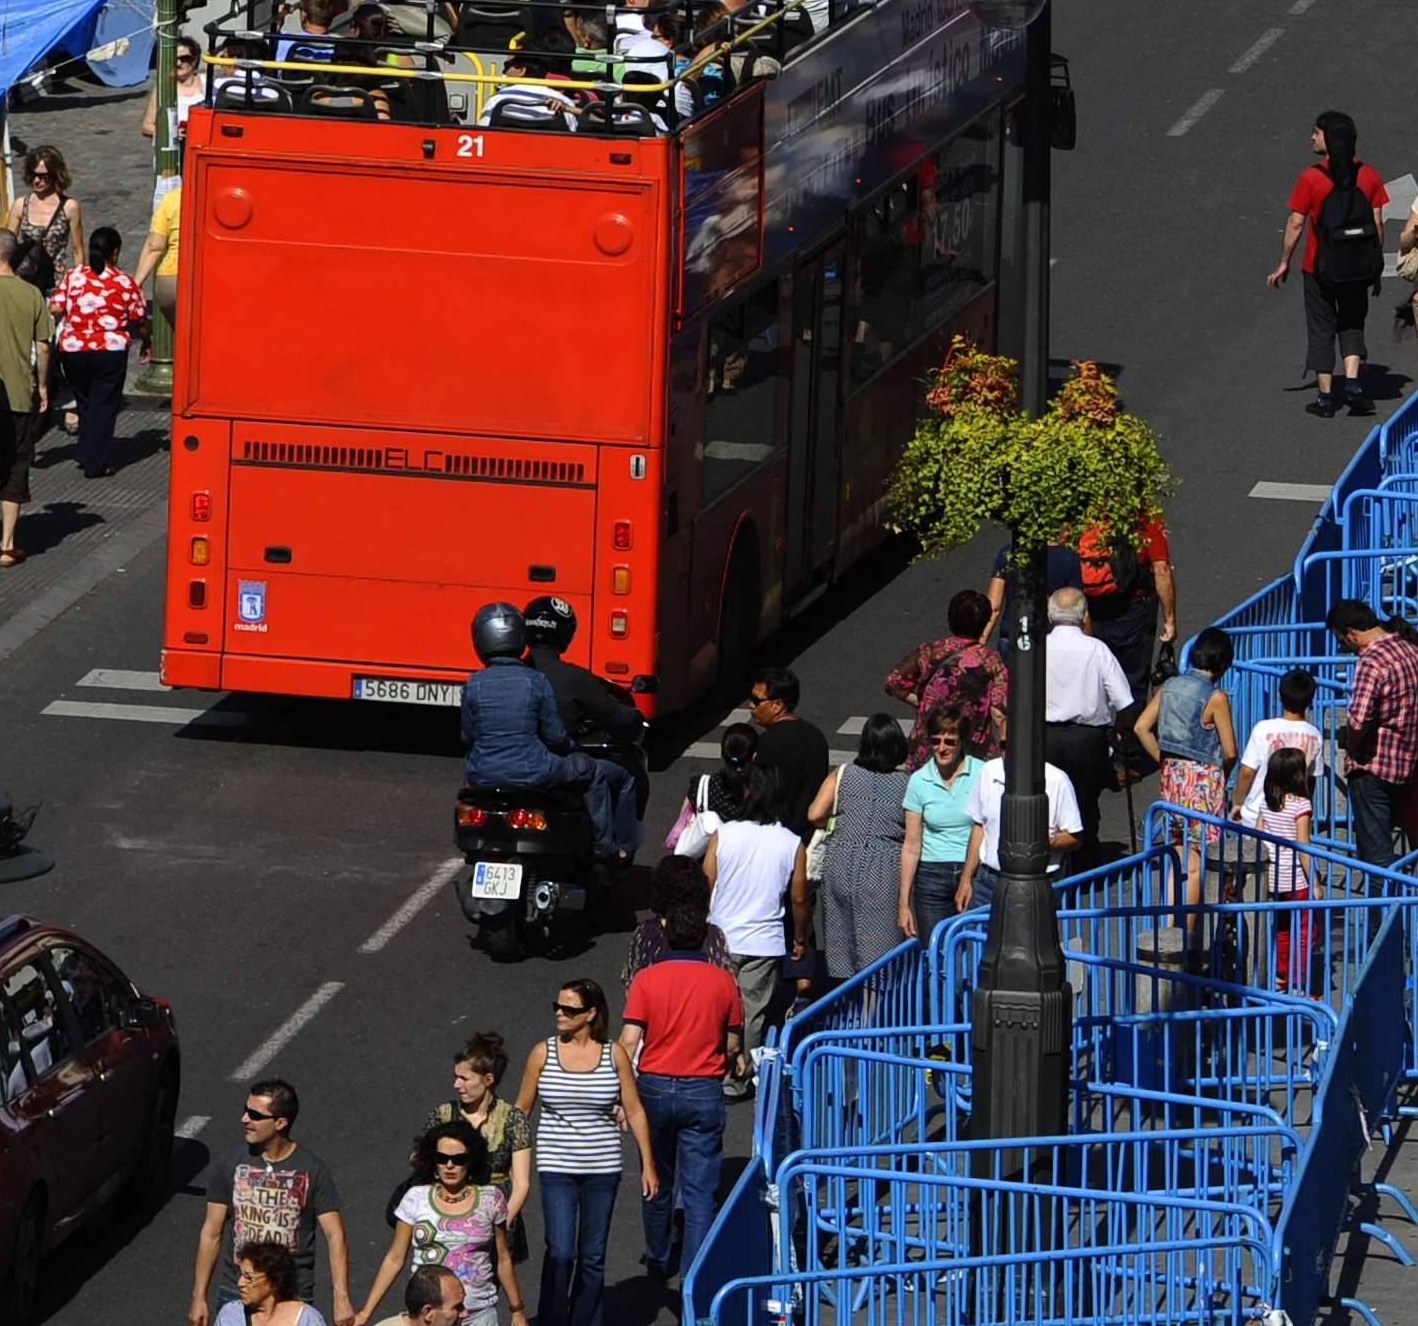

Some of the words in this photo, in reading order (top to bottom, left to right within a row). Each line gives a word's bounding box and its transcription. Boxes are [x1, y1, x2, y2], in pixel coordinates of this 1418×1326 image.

[457, 135, 484, 158] 21
[234, 622, 268, 633] madrid
[365, 680, 410, 700] 5686
[415, 683, 449, 702] DNY
[485, 865, 516, 881] 6413
[484, 881, 508, 896] GKJ
[256, 1188, 288, 1207] THE
[240, 1204, 271, 1224] KING
[278, 1212, 290, 1228] IS
